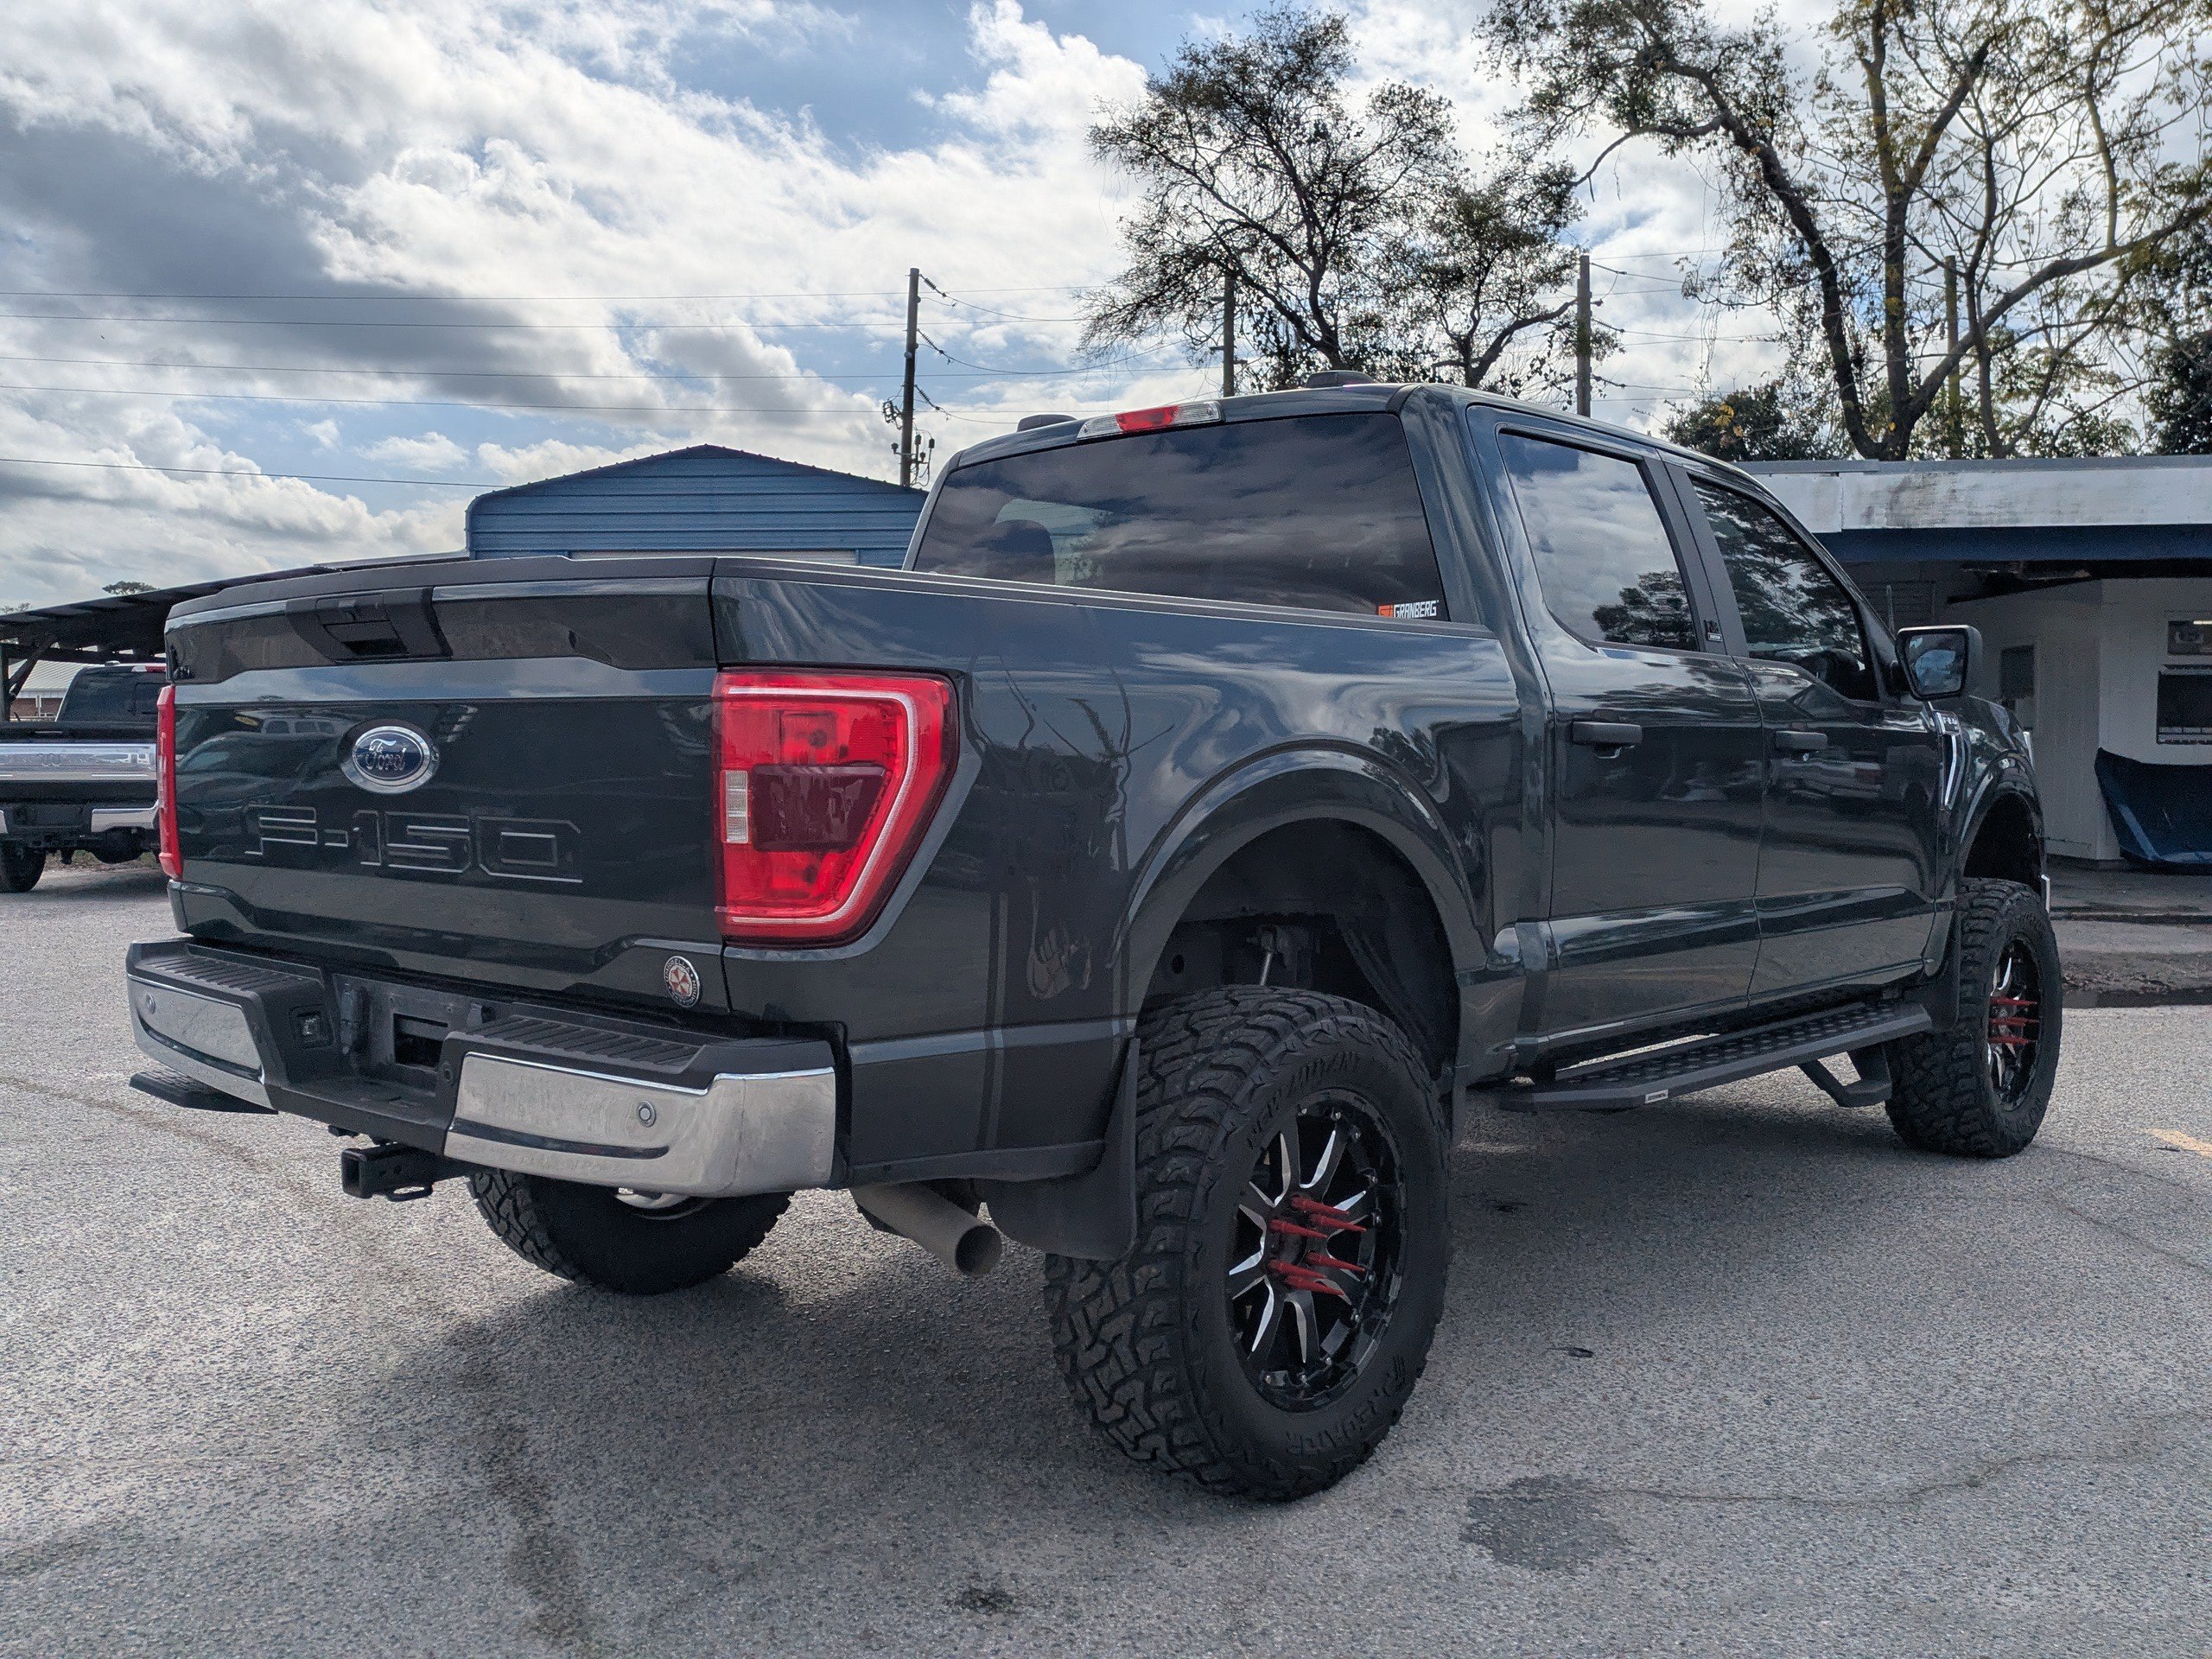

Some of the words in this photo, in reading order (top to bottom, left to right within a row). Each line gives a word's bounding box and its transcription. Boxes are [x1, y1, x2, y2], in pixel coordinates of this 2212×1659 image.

[1393, 600, 1437, 618] GRANBERG
[365, 738, 406, 771] Ford
[242, 804, 583, 884] F-150
